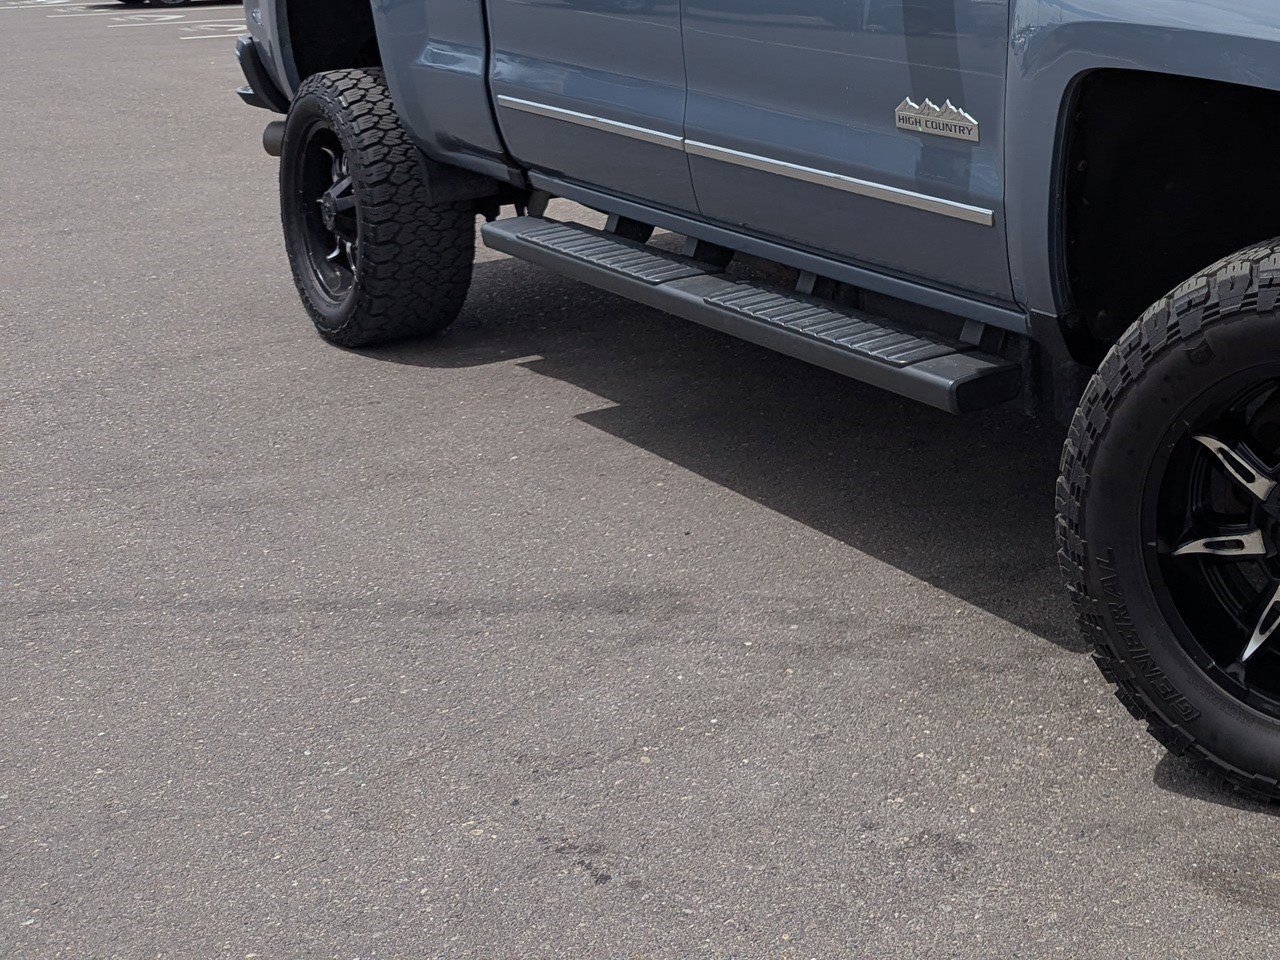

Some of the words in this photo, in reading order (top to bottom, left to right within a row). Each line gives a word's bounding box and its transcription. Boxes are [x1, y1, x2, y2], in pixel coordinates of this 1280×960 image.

[898, 115, 921, 126] HIGH
[925, 120, 973, 135] COUNTRY
[1095, 547, 1201, 721] GENERAL
